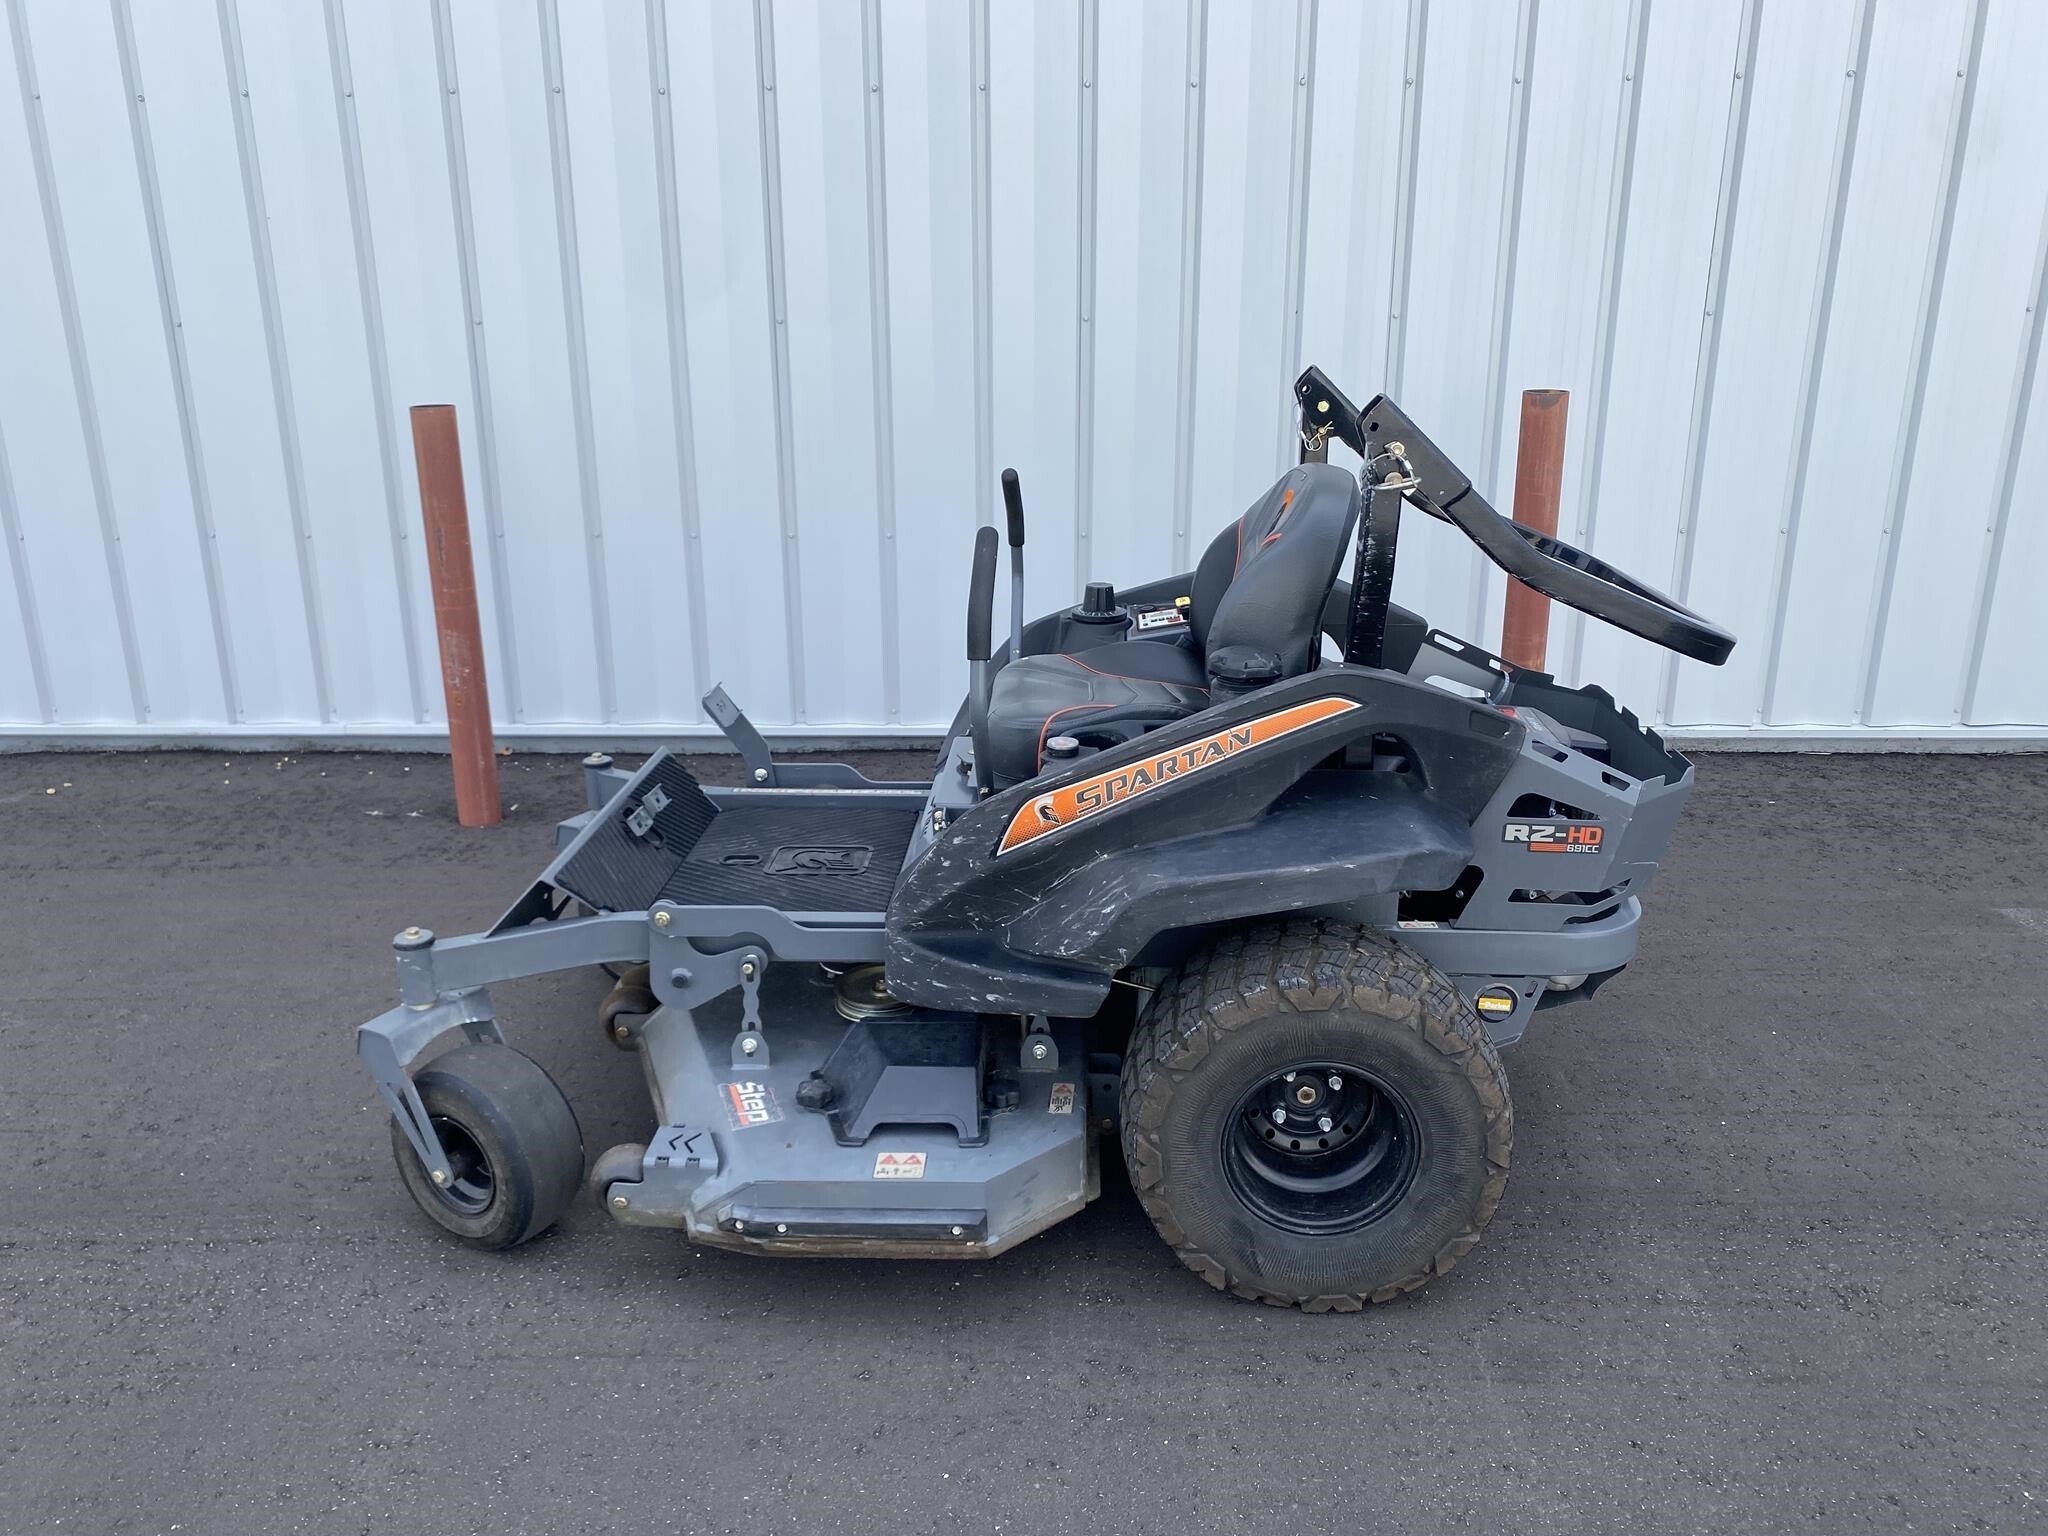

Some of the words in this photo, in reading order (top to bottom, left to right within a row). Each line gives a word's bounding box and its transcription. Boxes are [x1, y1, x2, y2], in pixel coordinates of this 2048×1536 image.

[1076, 729, 1252, 815] SPARTAN
[1505, 824, 1603, 844] RZ-HD
[1567, 844, 1600, 853] 691CC
